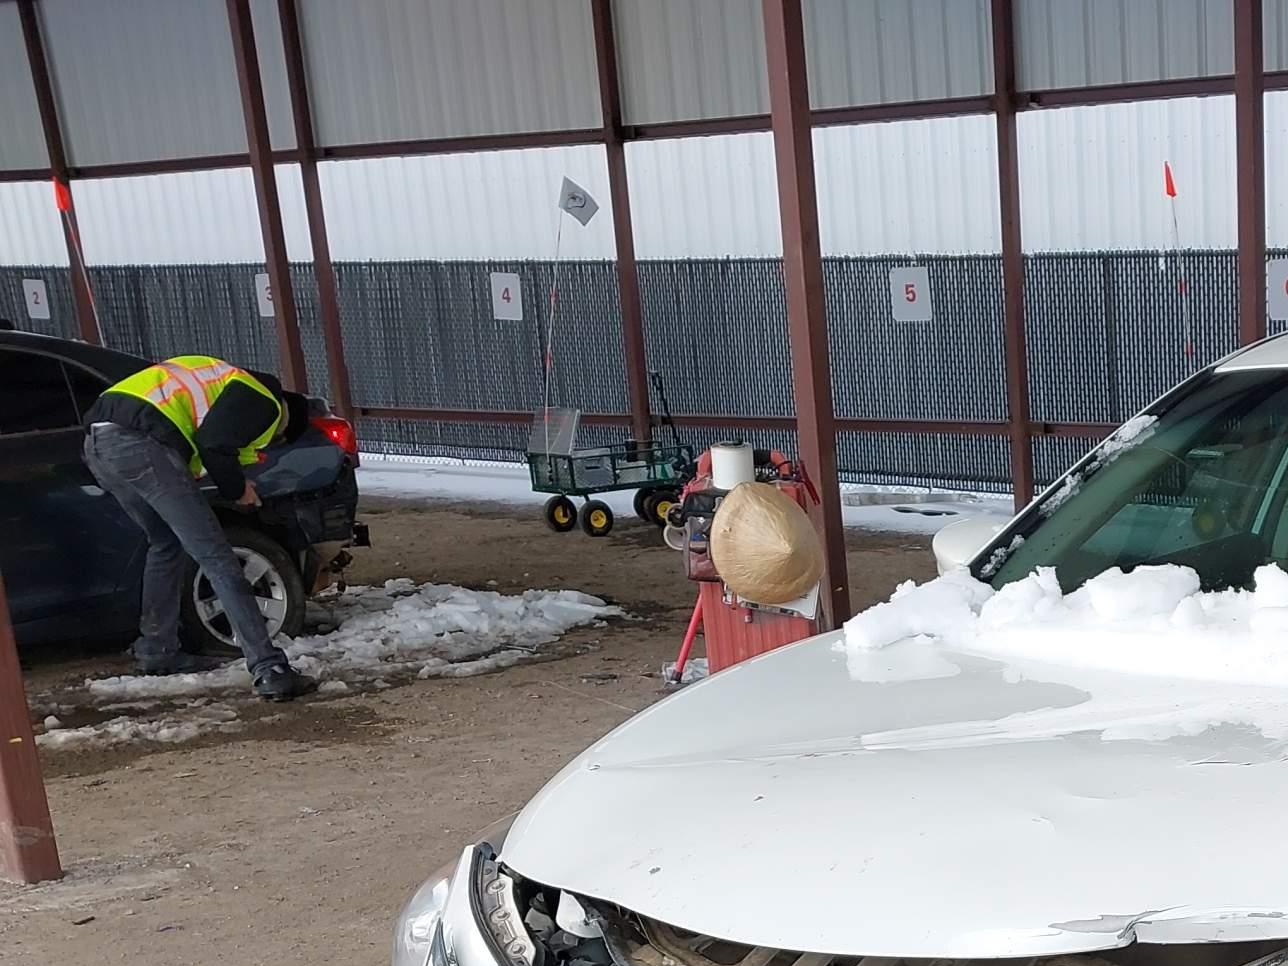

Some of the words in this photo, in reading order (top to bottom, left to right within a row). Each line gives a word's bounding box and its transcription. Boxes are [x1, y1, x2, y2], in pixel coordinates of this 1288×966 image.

[32, 291, 41, 305] 2
[502, 287, 511, 303] 4
[904, 283, 917, 302] 5
